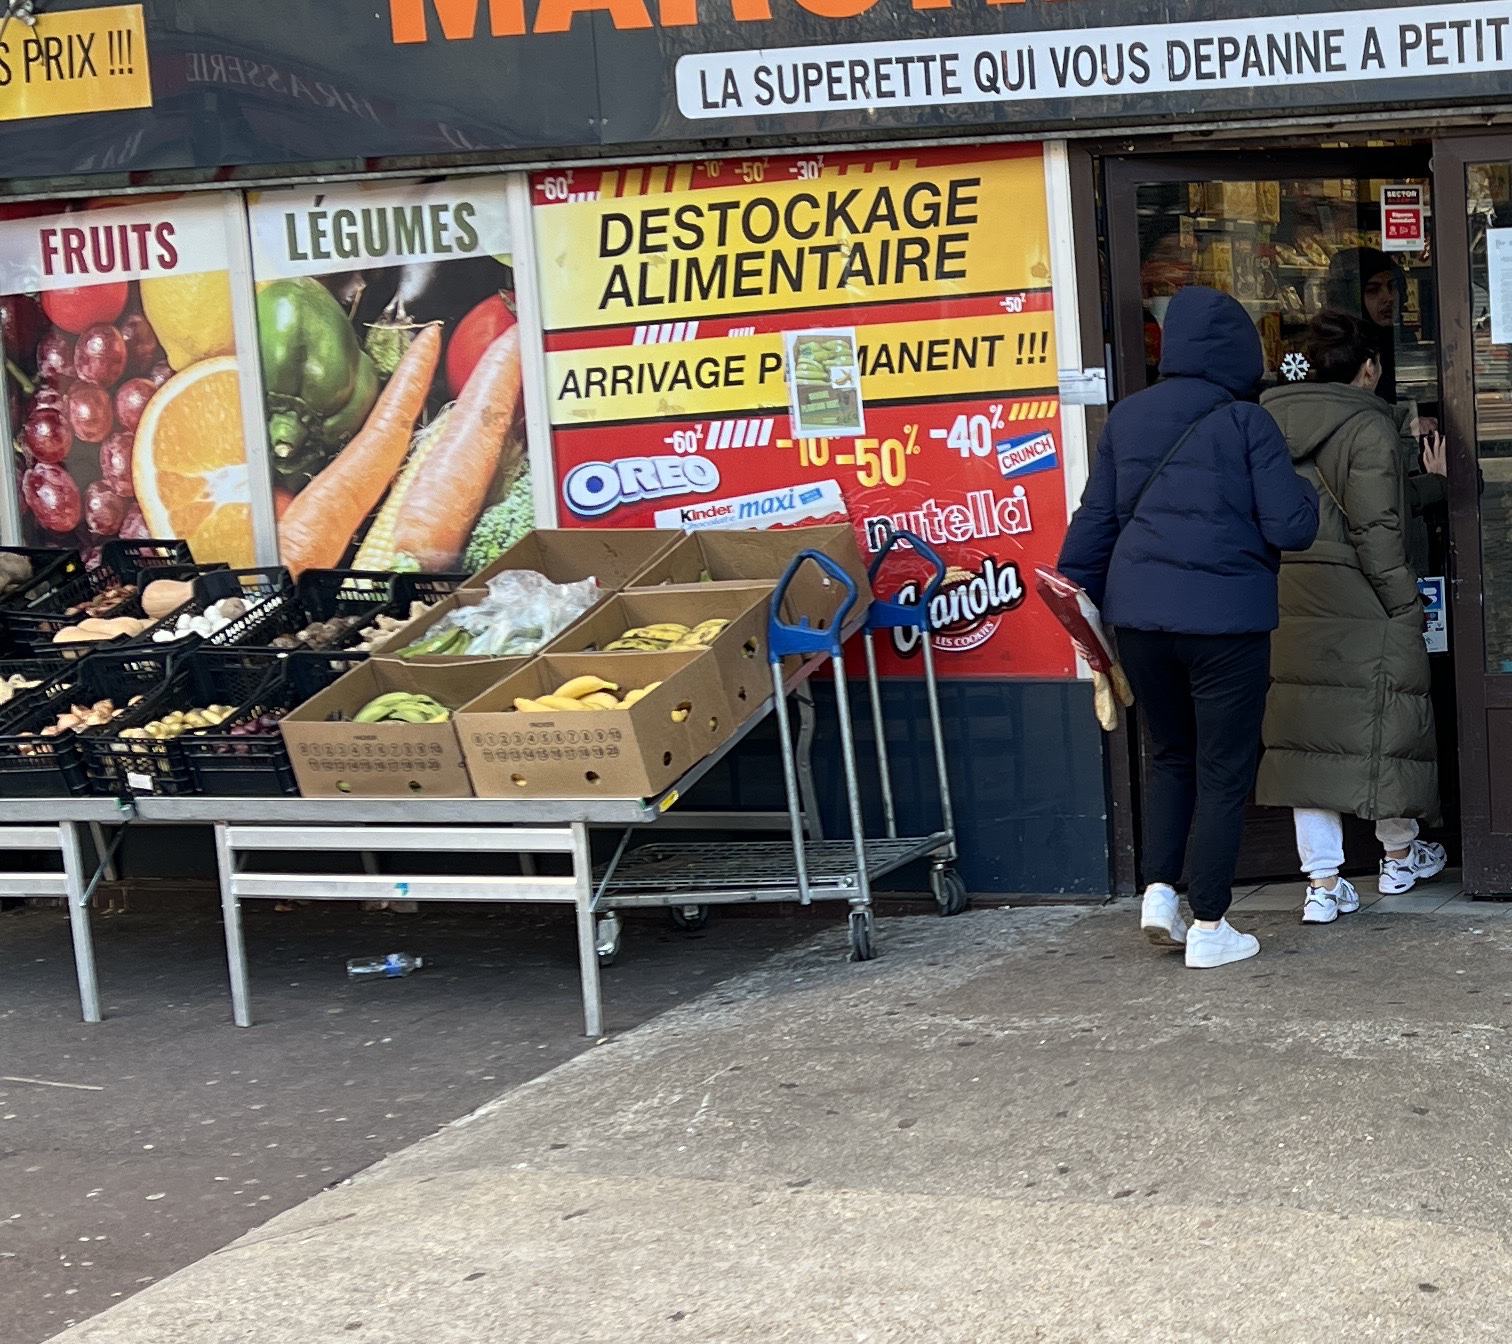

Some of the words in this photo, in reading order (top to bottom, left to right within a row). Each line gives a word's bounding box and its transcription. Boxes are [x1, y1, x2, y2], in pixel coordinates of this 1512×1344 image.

[23, 32, 97, 84] PRIX
[107, 29, 134, 76] !!!
[701, 68, 743, 109] LA
[755, 52, 962, 106] SUPERETTE
[974, 45, 1038, 95] QUI
[1049, 39, 1151, 89] VOUS
[1169, 27, 1347, 81] DEPANNE
[1360, 25, 1387, 69] A
[1399, 17, 1511, 68] PETIT
[39, 220, 180, 277] FRUITS
[285, 195, 480, 261] LÉGUMES
[599, 177, 981, 259] DESTOCKAGE
[598, 232, 970, 311] ALIMENTAIRE
[558, 353, 747, 402] ARRIVAGE
[1015, 330, 1049, 368] !!!
[835, 424, 921, 487] -50%
[929, 404, 1005, 458] -40%
[1001, 435, 1054, 471] CRUNCH
[565, 457, 719, 514] OREO
[739, 488, 796, 520] maxi
[863, 485, 1032, 553] nutella
[935, 635, 953, 647] LES
[953, 621, 995, 647] COOKIES
